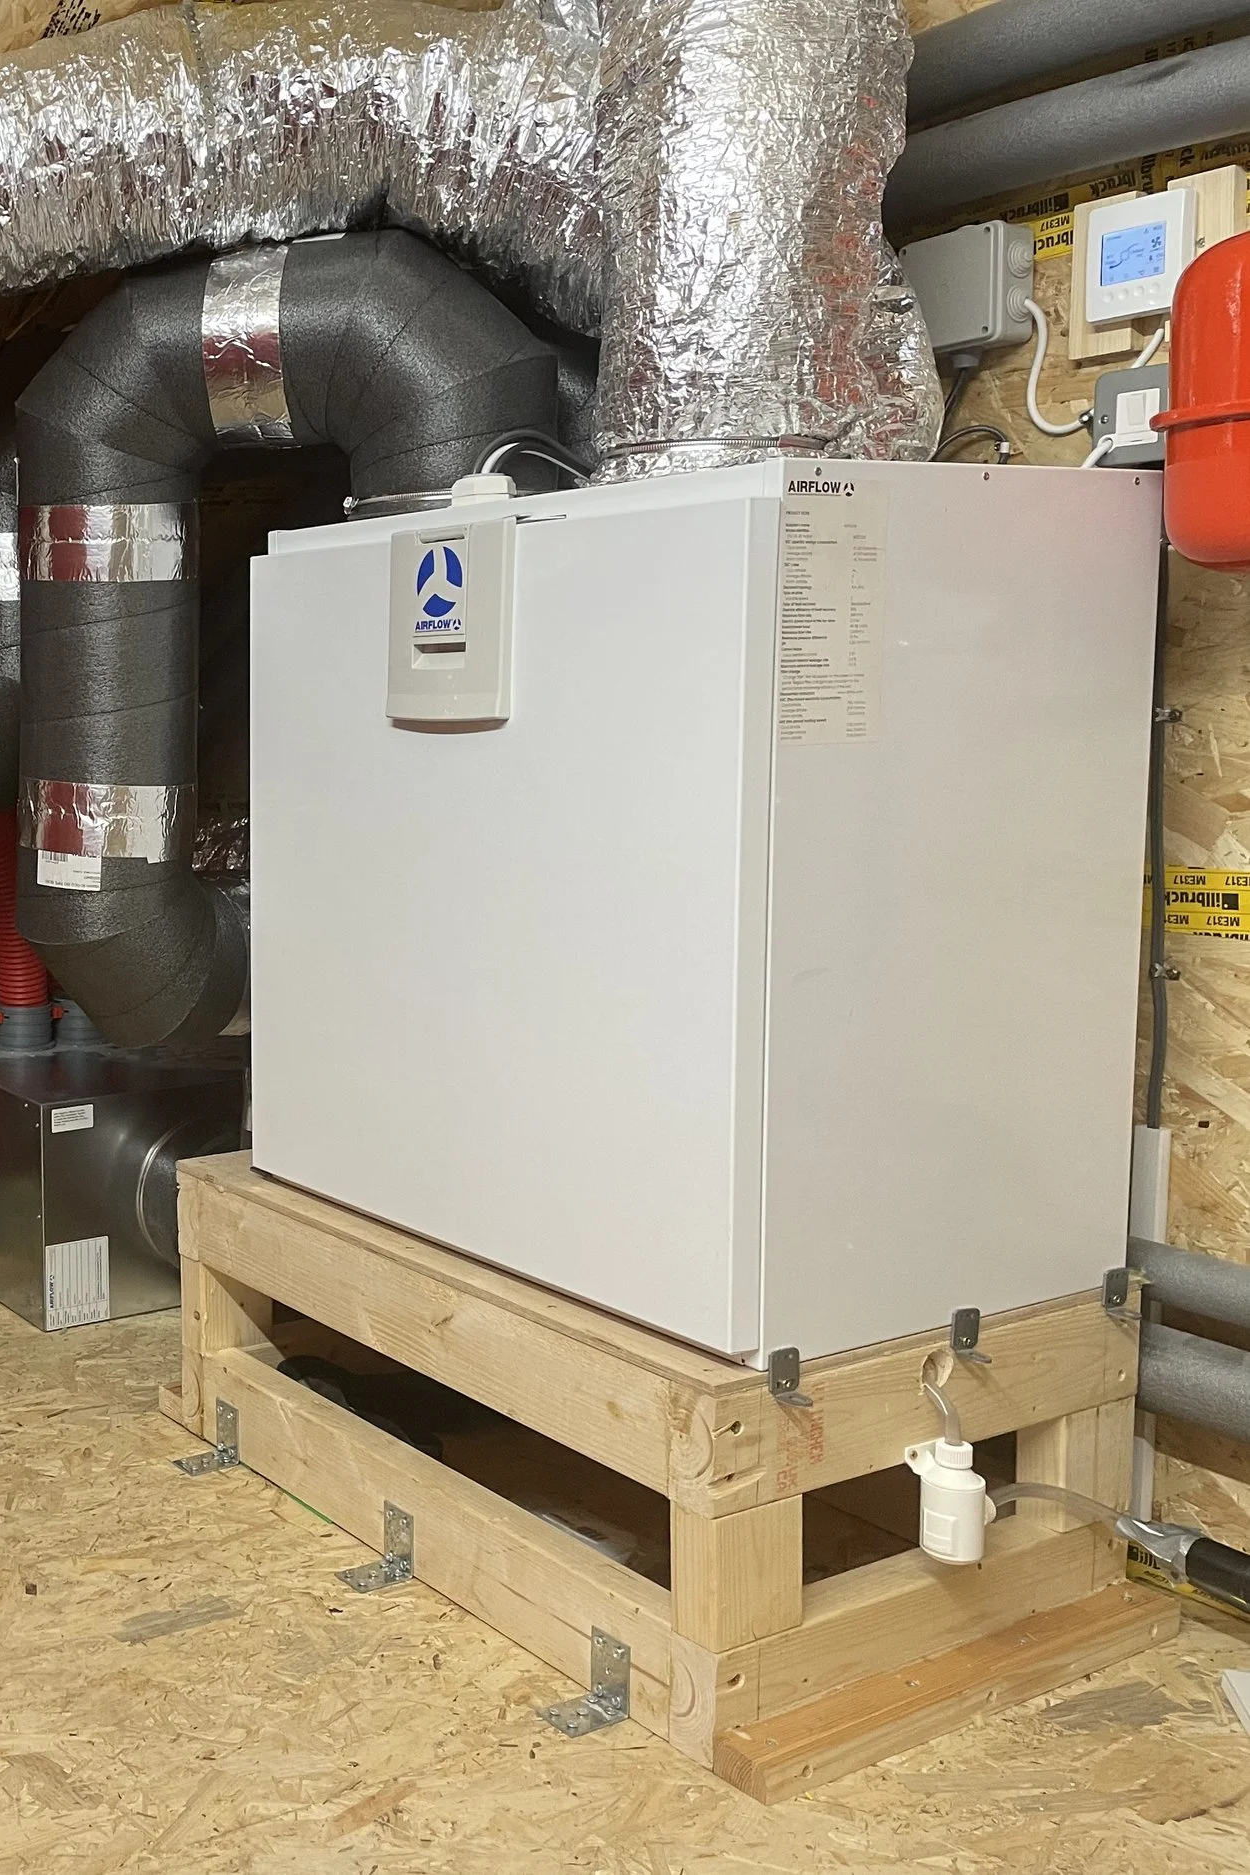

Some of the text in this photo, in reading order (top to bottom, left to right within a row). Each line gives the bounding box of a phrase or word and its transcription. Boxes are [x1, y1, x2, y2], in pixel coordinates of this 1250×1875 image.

[1039, 215, 1070, 232] ME317
[788, 480, 842, 494] AIRFLOW
[415, 619, 452, 631] AIRFLOW
[1173, 875, 1250, 887] ME317 E317
[1206, 915, 1240, 926] ME317
